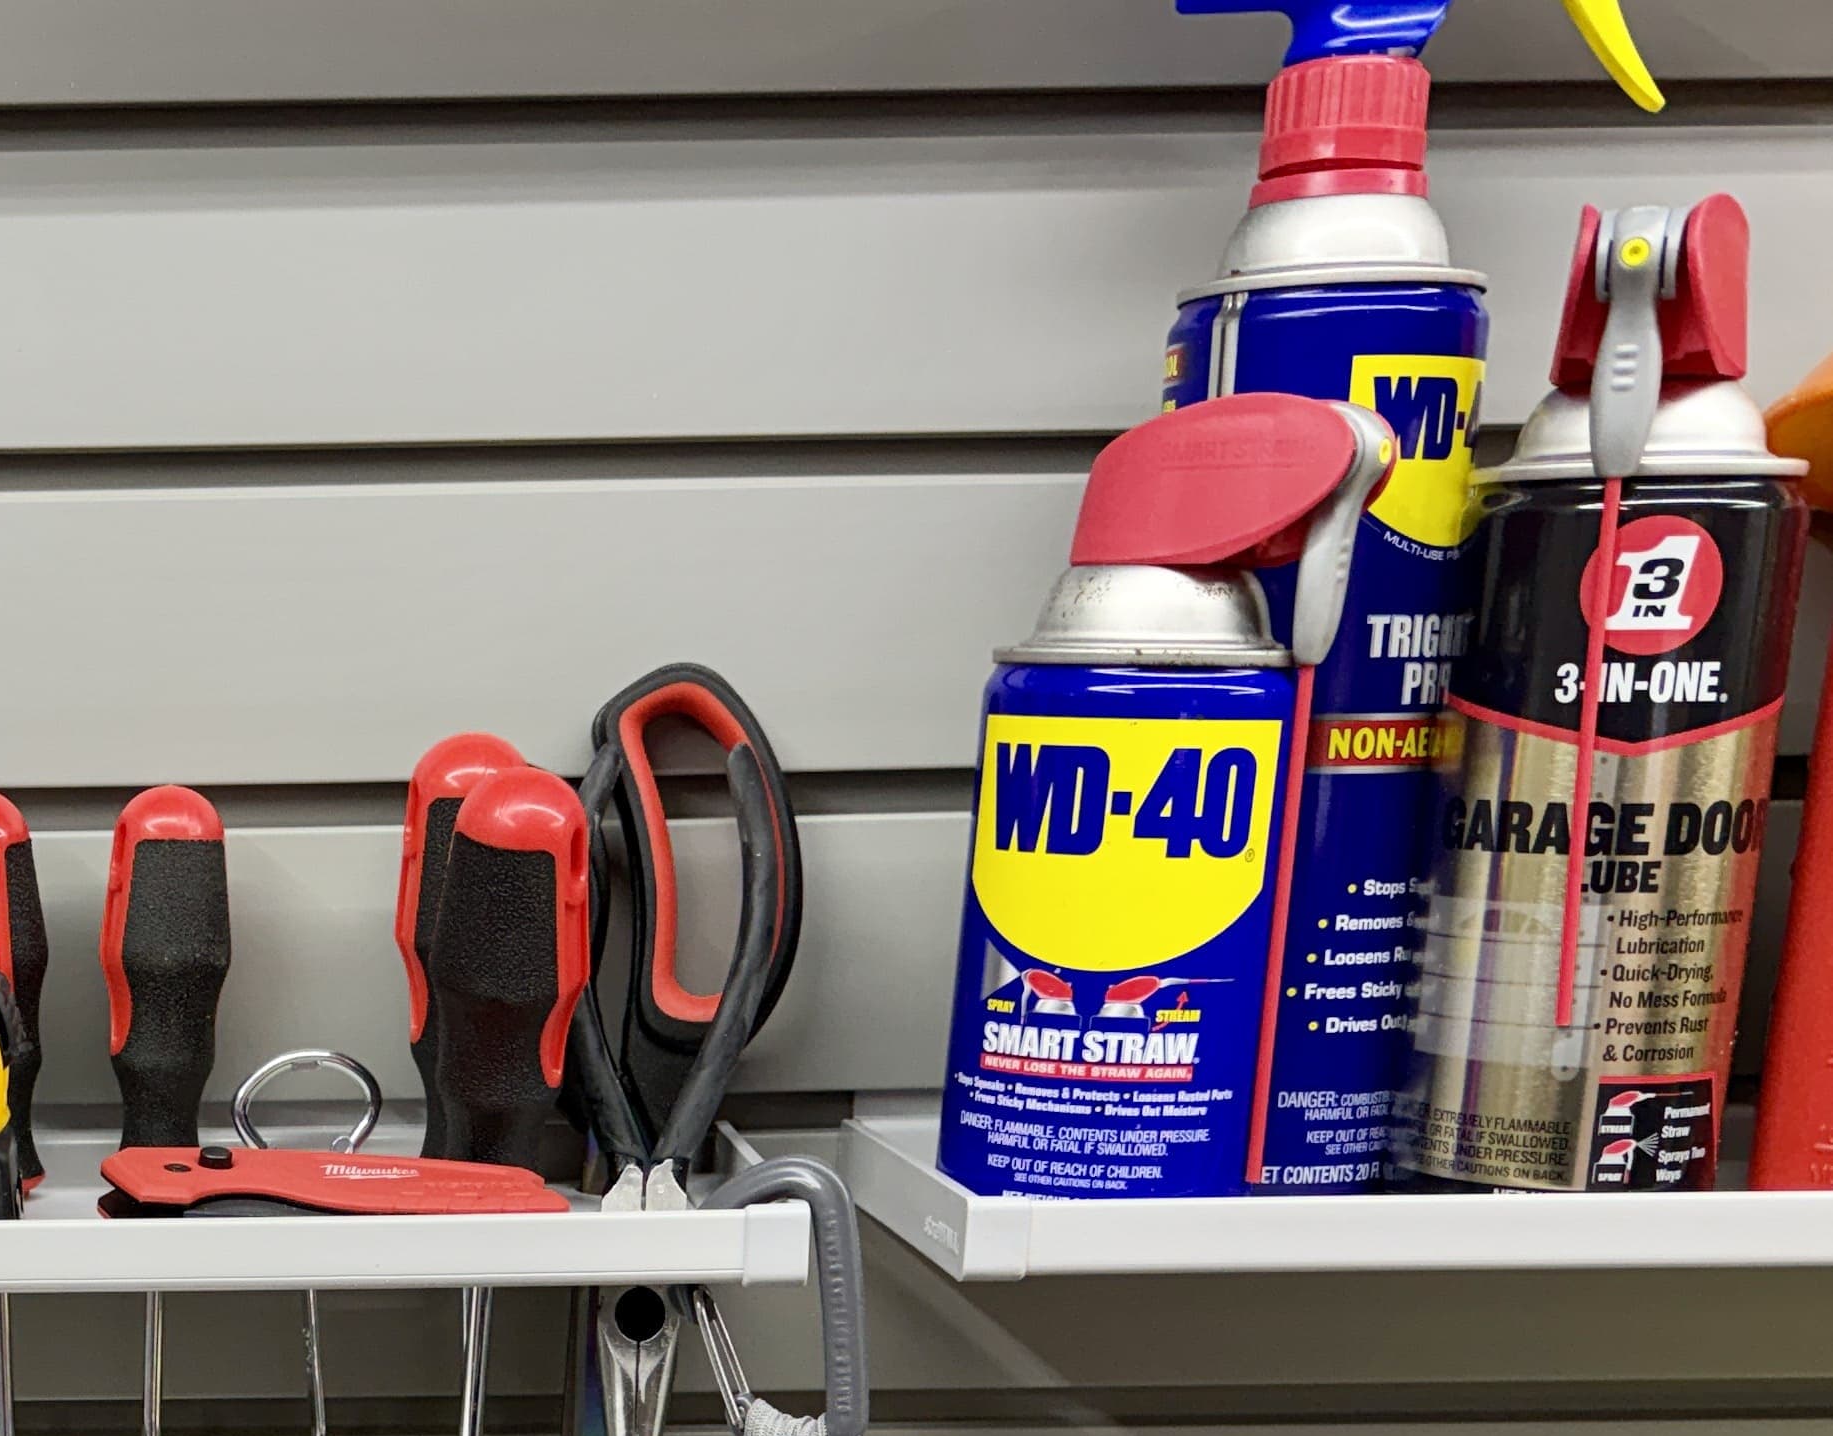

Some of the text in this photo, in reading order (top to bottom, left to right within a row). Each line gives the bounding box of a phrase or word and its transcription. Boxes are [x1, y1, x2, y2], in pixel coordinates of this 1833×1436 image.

[1384, 531, 1444, 561] MULTI-USE
[1605, 535, 1700, 630] 1
[1632, 558, 1685, 600] 3
[1632, 605, 1666, 618] IN
[1367, 613, 1441, 658] TRIG
[1328, 727, 1430, 760] NON-AE
[996, 742, 1257, 858] WD-40
[1442, 797, 1654, 857] GARAGE
[1581, 861, 1661, 893] UBE
[1363, 879, 1405, 899] Stops
[1335, 914, 1403, 931] Removes
[1616, 936, 1705, 954] Lubrication
[1324, 949, 1390, 966] Loosens
[1304, 981, 1402, 1000] Frees Sticky
[987, 998, 1015, 1013] SPRAY
[1609, 992, 1633, 1009] No
[1637, 991, 1678, 1008] Mess
[1325, 1016, 1377, 1034] Drives
[1604, 1016, 1708, 1035] Prevents Rust
[982, 1021, 1201, 1065] SMART STRAW
[1602, 1044, 1694, 1062] & Corrosion
[984, 1056, 1020, 1071] NEVER
[1023, 1062, 1056, 1074] LOSE
[1059, 1064, 1087, 1077] THE
[1091, 1065, 1142, 1078] STRAW
[1014, 1082, 1060, 1098] Removes
[1061, 1087, 1070, 1099] &
[1072, 1088, 1120, 1102] Protects
[1133, 1091, 1176, 1102] Loosens
[1277, 1091, 1339, 1108] DANGER:
[1104, 1104, 1140, 1116] Drives
[1142, 1105, 1161, 1116] Out
[1162, 1104, 1208, 1116] Moisture
[1304, 1106, 1368, 1121] HARMFUL OR
[1433, 1108, 1494, 1129] EXTREMELY
[1058, 1126, 1117, 1142] CONTENTS
[1120, 1130, 1158, 1143] UNDER
[1306, 1130, 1333, 1143] KEEP
[1335, 1129, 1356, 1143] OUT
[1356, 1128, 1369, 1141] OF
[1661, 1125, 1691, 1139] Straw
[987, 1131, 1031, 1149] HARMFUL
[1033, 1138, 1048, 1151] OR
[1050, 1139, 1082, 1154] FATAL
[1084, 1142, 1095, 1154] IF
[1325, 1144, 1341, 1155] SEE
[987, 1153, 1010, 1168] KEEP
[1011, 1157, 1032, 1171] OUT
[1033, 1160, 1049, 1173] OF
[1050, 1161, 1087, 1177] REACH
[1089, 1164, 1105, 1178] OF
[1657, 1150, 1690, 1165] Sprays
[1014, 1172, 1027, 1183] SEE
[1261, 1166, 1281, 1185] ET
[1283, 1163, 1353, 1185] CONTENTS
[1355, 1162, 1369, 1181] 20
[1513, 1168, 1529, 1179] ON
[1655, 1169, 1682, 1183] Ways
